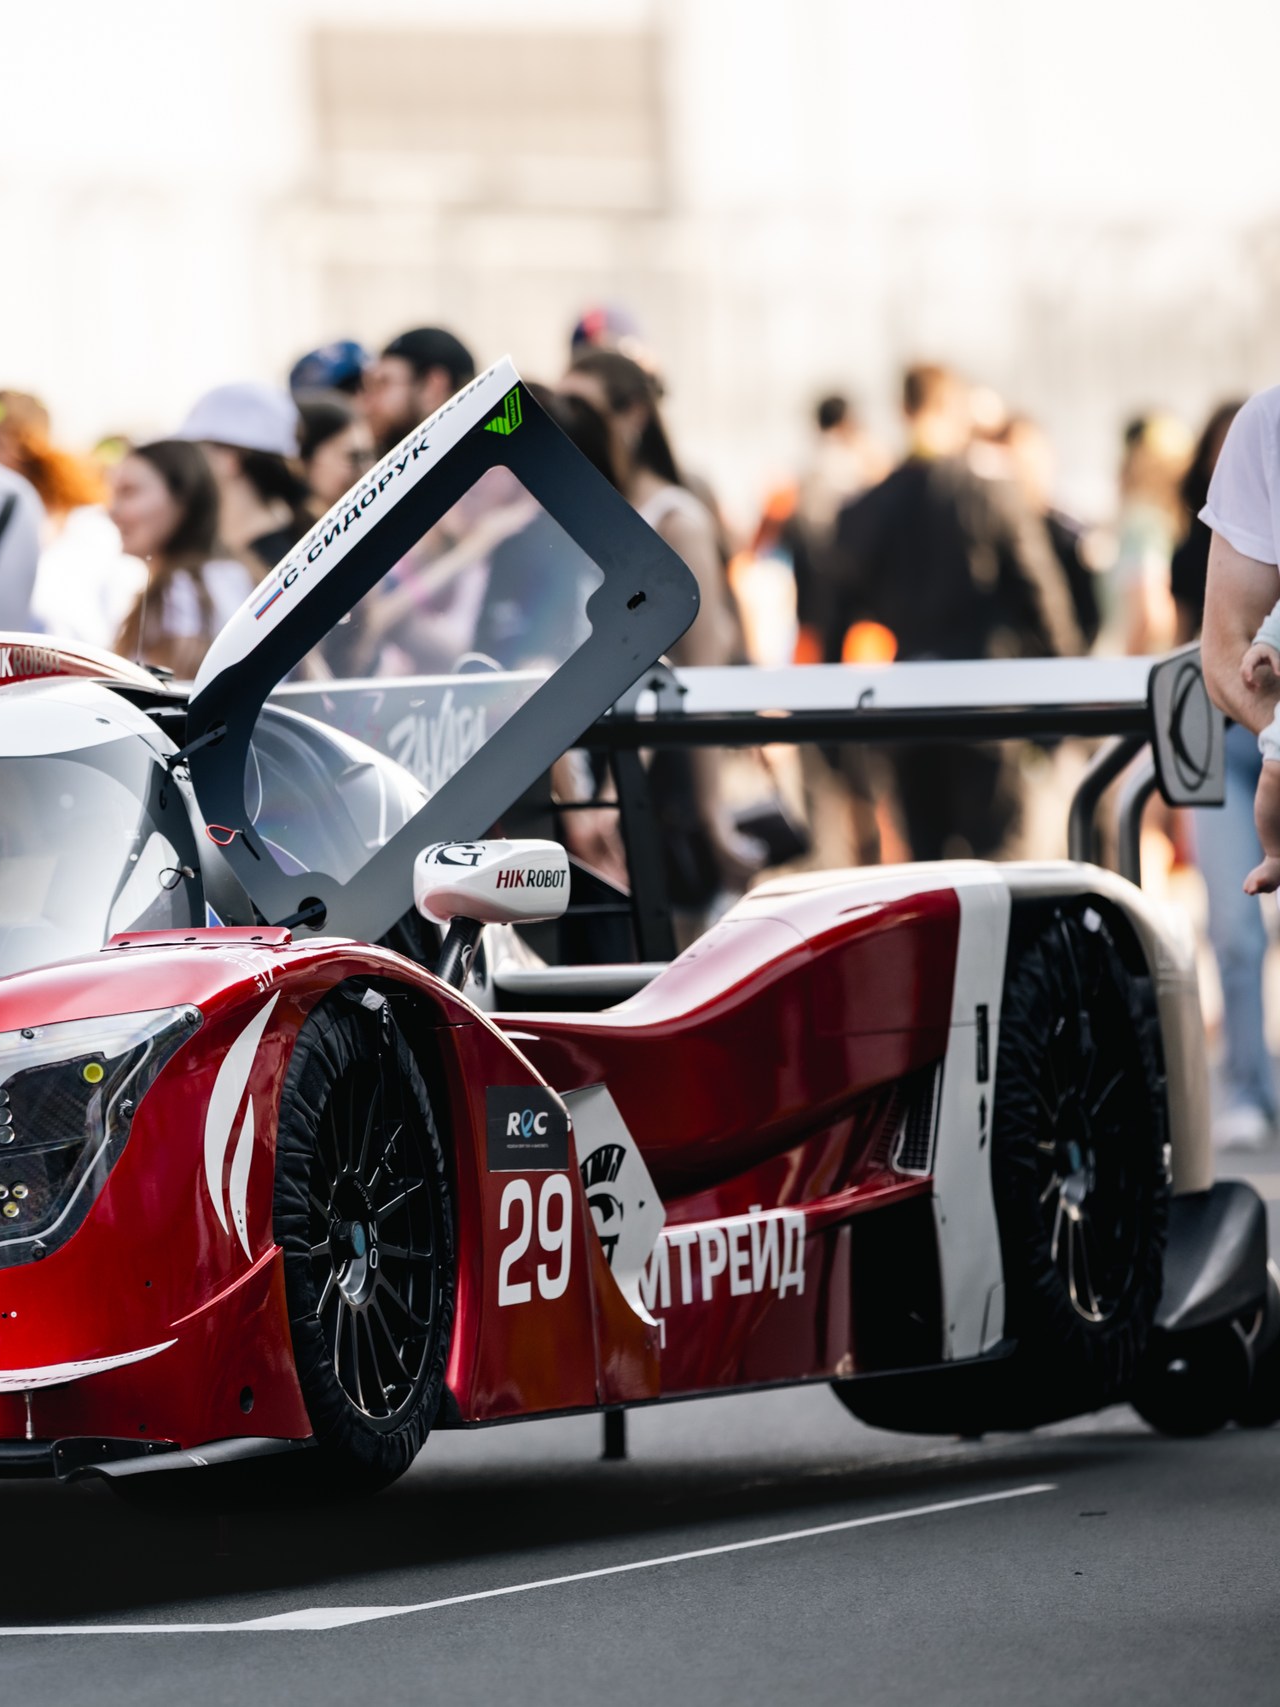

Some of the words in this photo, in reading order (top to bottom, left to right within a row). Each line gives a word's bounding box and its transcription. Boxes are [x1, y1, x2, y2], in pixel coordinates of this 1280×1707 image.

[283, 436, 431, 590] С.СИДОРУК
[496, 869, 567, 889] HIKROBOT
[498, 1174, 572, 1307] 29
